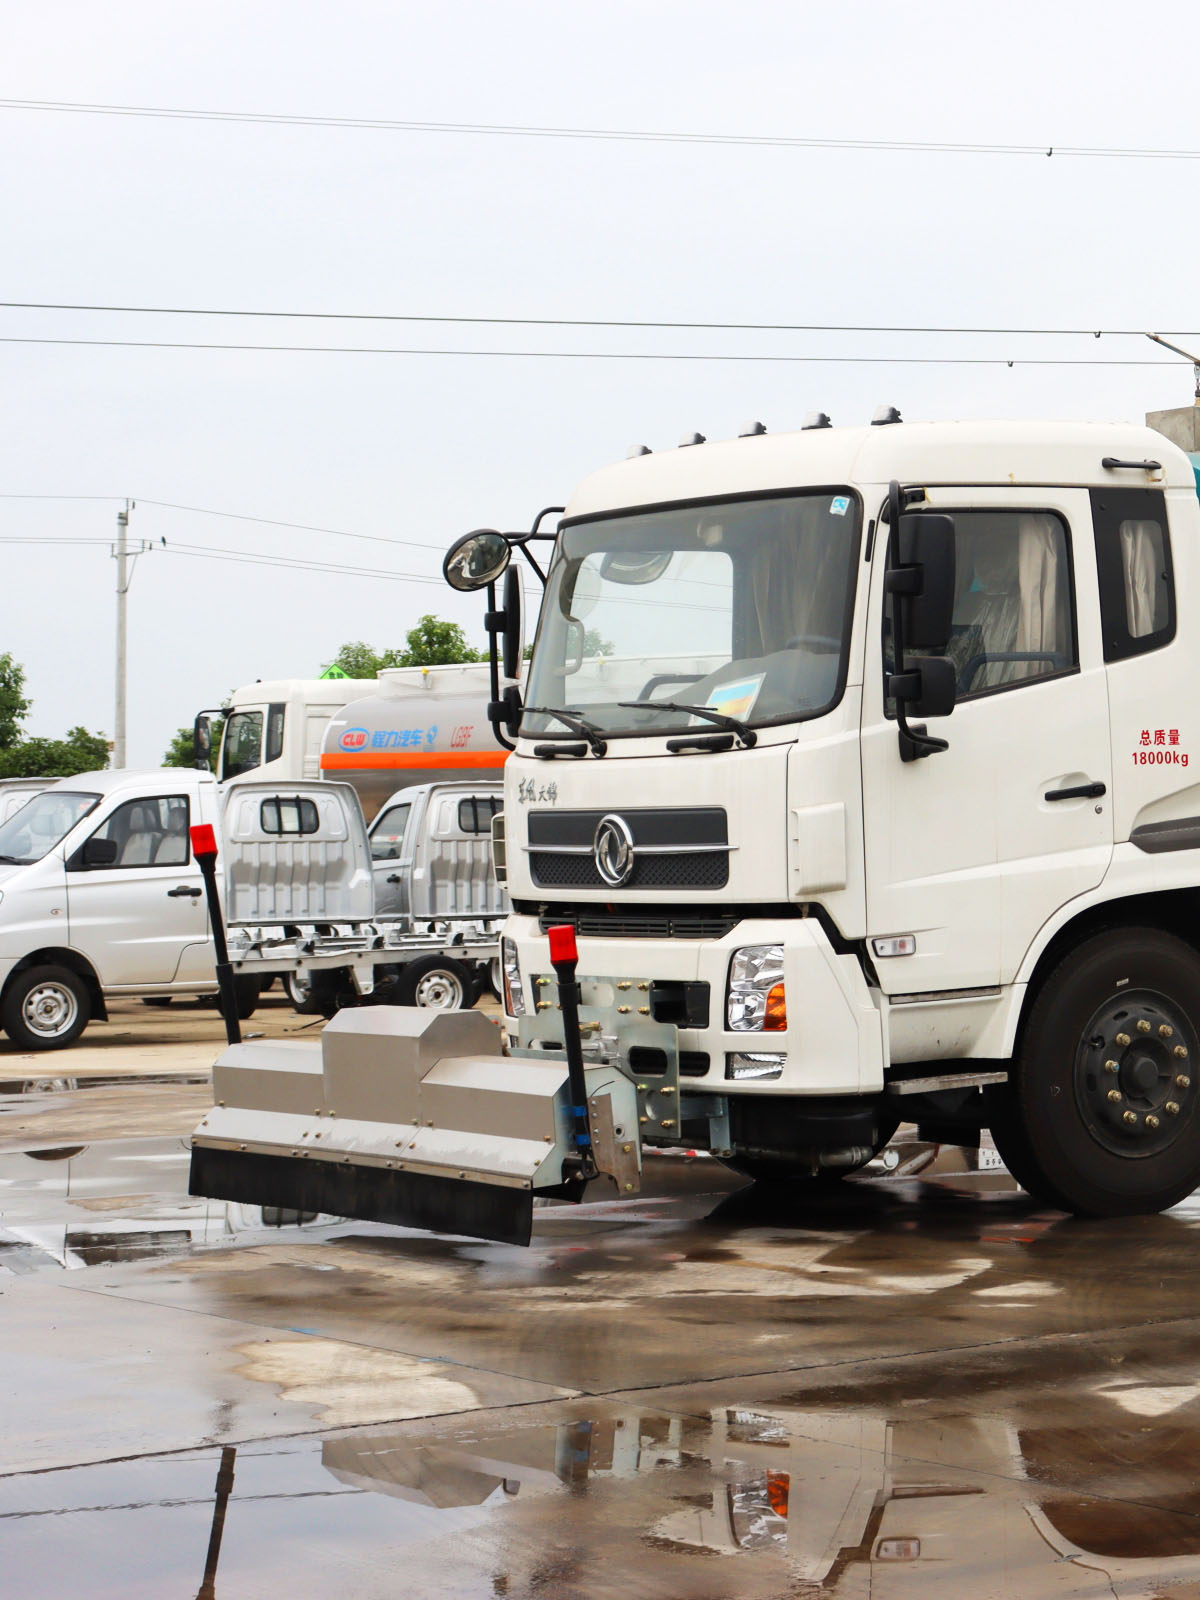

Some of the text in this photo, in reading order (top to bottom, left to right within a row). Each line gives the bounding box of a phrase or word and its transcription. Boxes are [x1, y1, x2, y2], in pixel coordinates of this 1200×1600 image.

[342, 733, 366, 747] CLW
[372, 729, 425, 748] 程力汽车
[1139, 729, 1180, 746] 总质量
[1131, 751, 1189, 767] 18000kg
